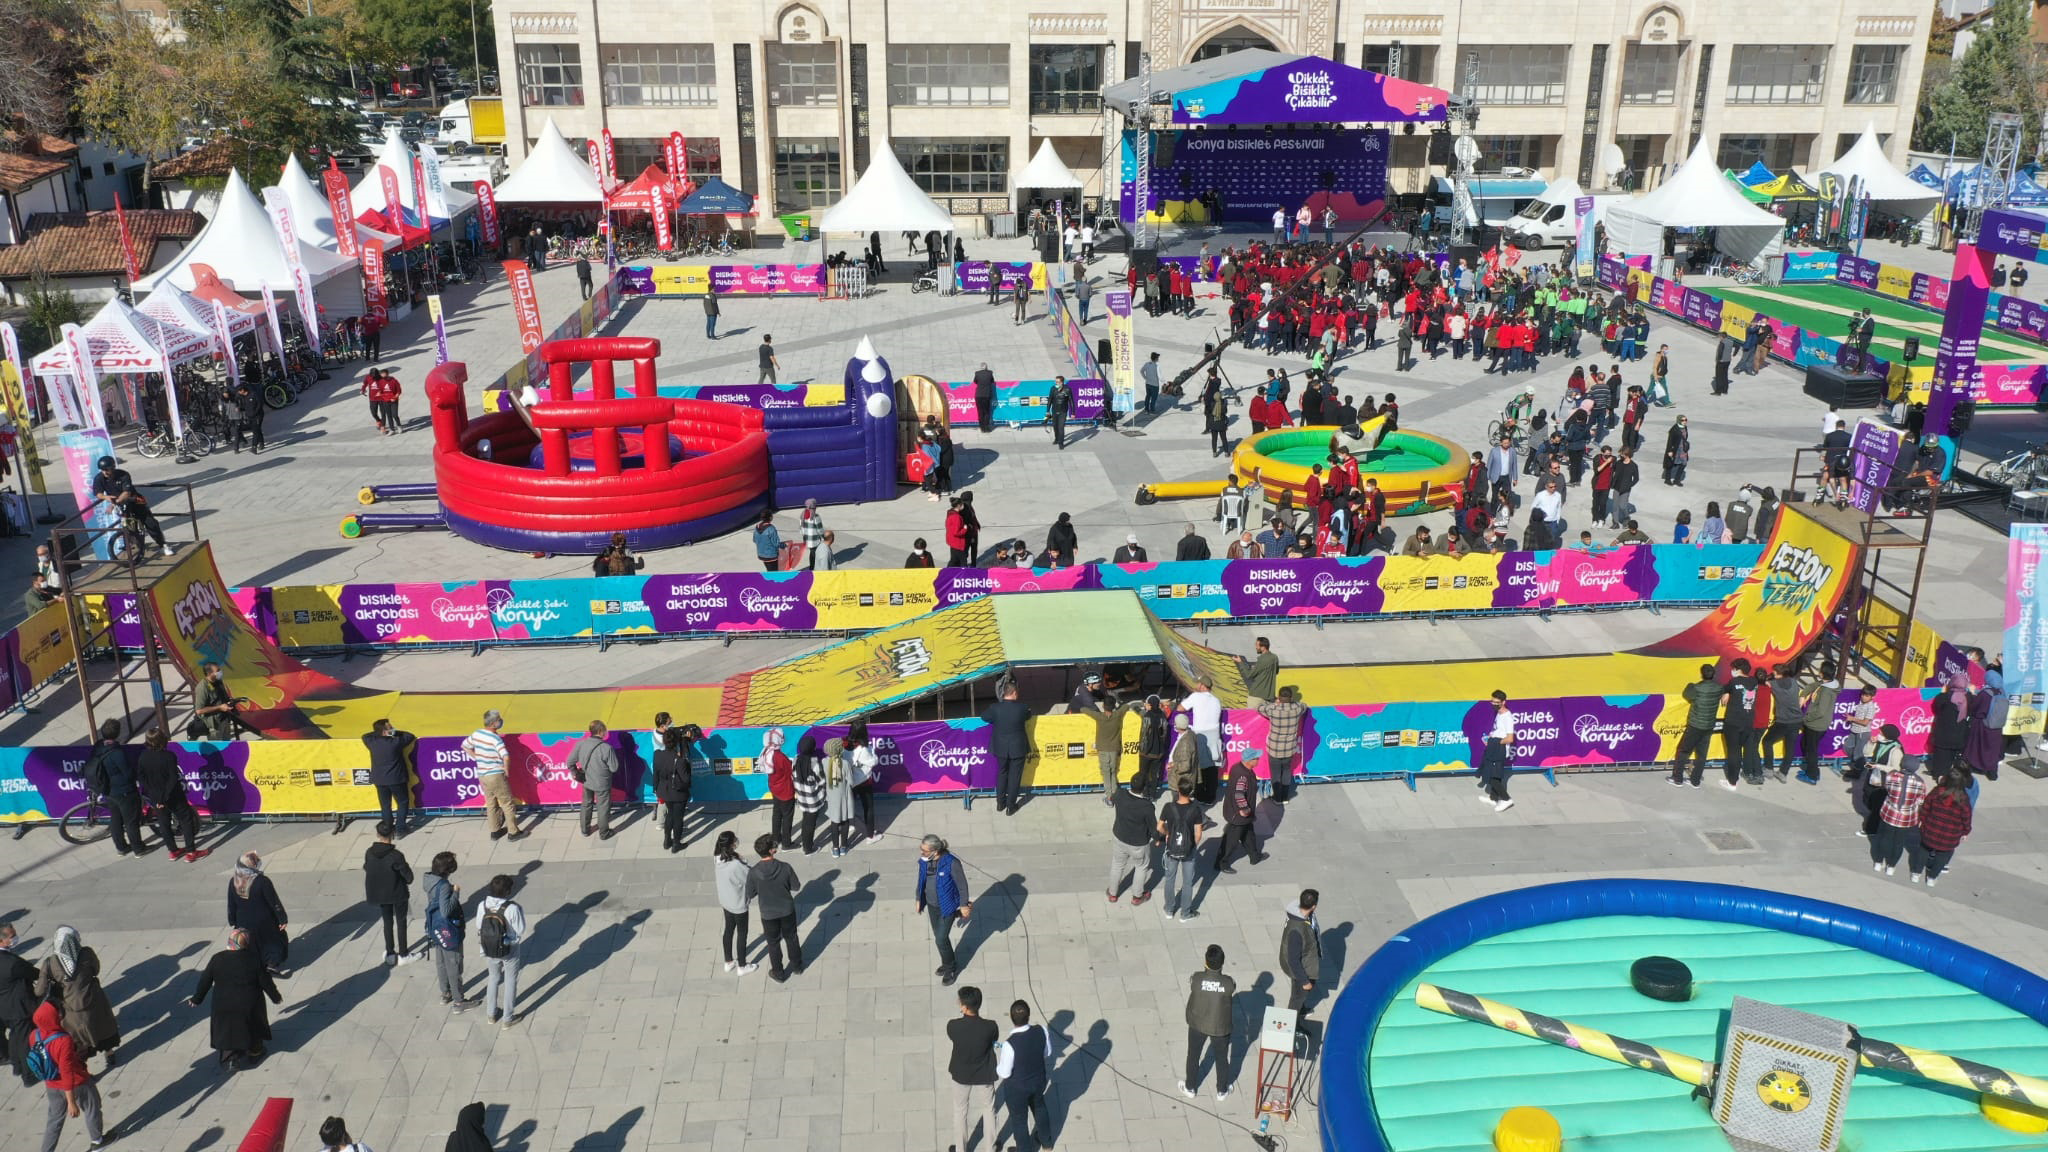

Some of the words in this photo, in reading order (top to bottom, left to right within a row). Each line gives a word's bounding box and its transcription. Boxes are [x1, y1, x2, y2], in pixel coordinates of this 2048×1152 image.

[1188, 139, 1225, 152] konya
[1227, 138, 1272, 150] bisiklet
[1274, 138, 1325, 150] festivali
[365, 248, 378, 302] FALCON
[167, 340, 209, 361] KRON
[39, 358, 153, 370] KON
[1078, 399, 1104, 408] futbo
[1768, 541, 1832, 592] ACTION
[1250, 569, 1296, 580] bisiklet
[1580, 572, 1621, 591] Konya
[671, 585, 721, 595] bisiklet
[953, 578, 1000, 589] bisiklet
[1243, 582, 1301, 594] akrobasi
[1319, 583, 1364, 601] Konya
[359, 594, 410, 605] bisiklet
[666, 598, 728, 610] akrobasi
[1260, 598, 1284, 609] şov
[174, 580, 221, 636] ACTION
[355, 608, 419, 620] akrobasi
[747, 597, 794, 618] Konya
[440, 606, 488, 628] Konya
[496, 603, 561, 631] Konya
[686, 612, 710, 623] şov
[376, 622, 401, 636] şov
[1513, 711, 1554, 724] siklet
[1515, 727, 1559, 740] obasi
[1905, 720, 1932, 735] Kon
[1580, 726, 1635, 749] Konya
[1509, 746, 1536, 760] şov
[928, 749, 985, 775] Konya
[2, 785, 38, 793] KONYA
